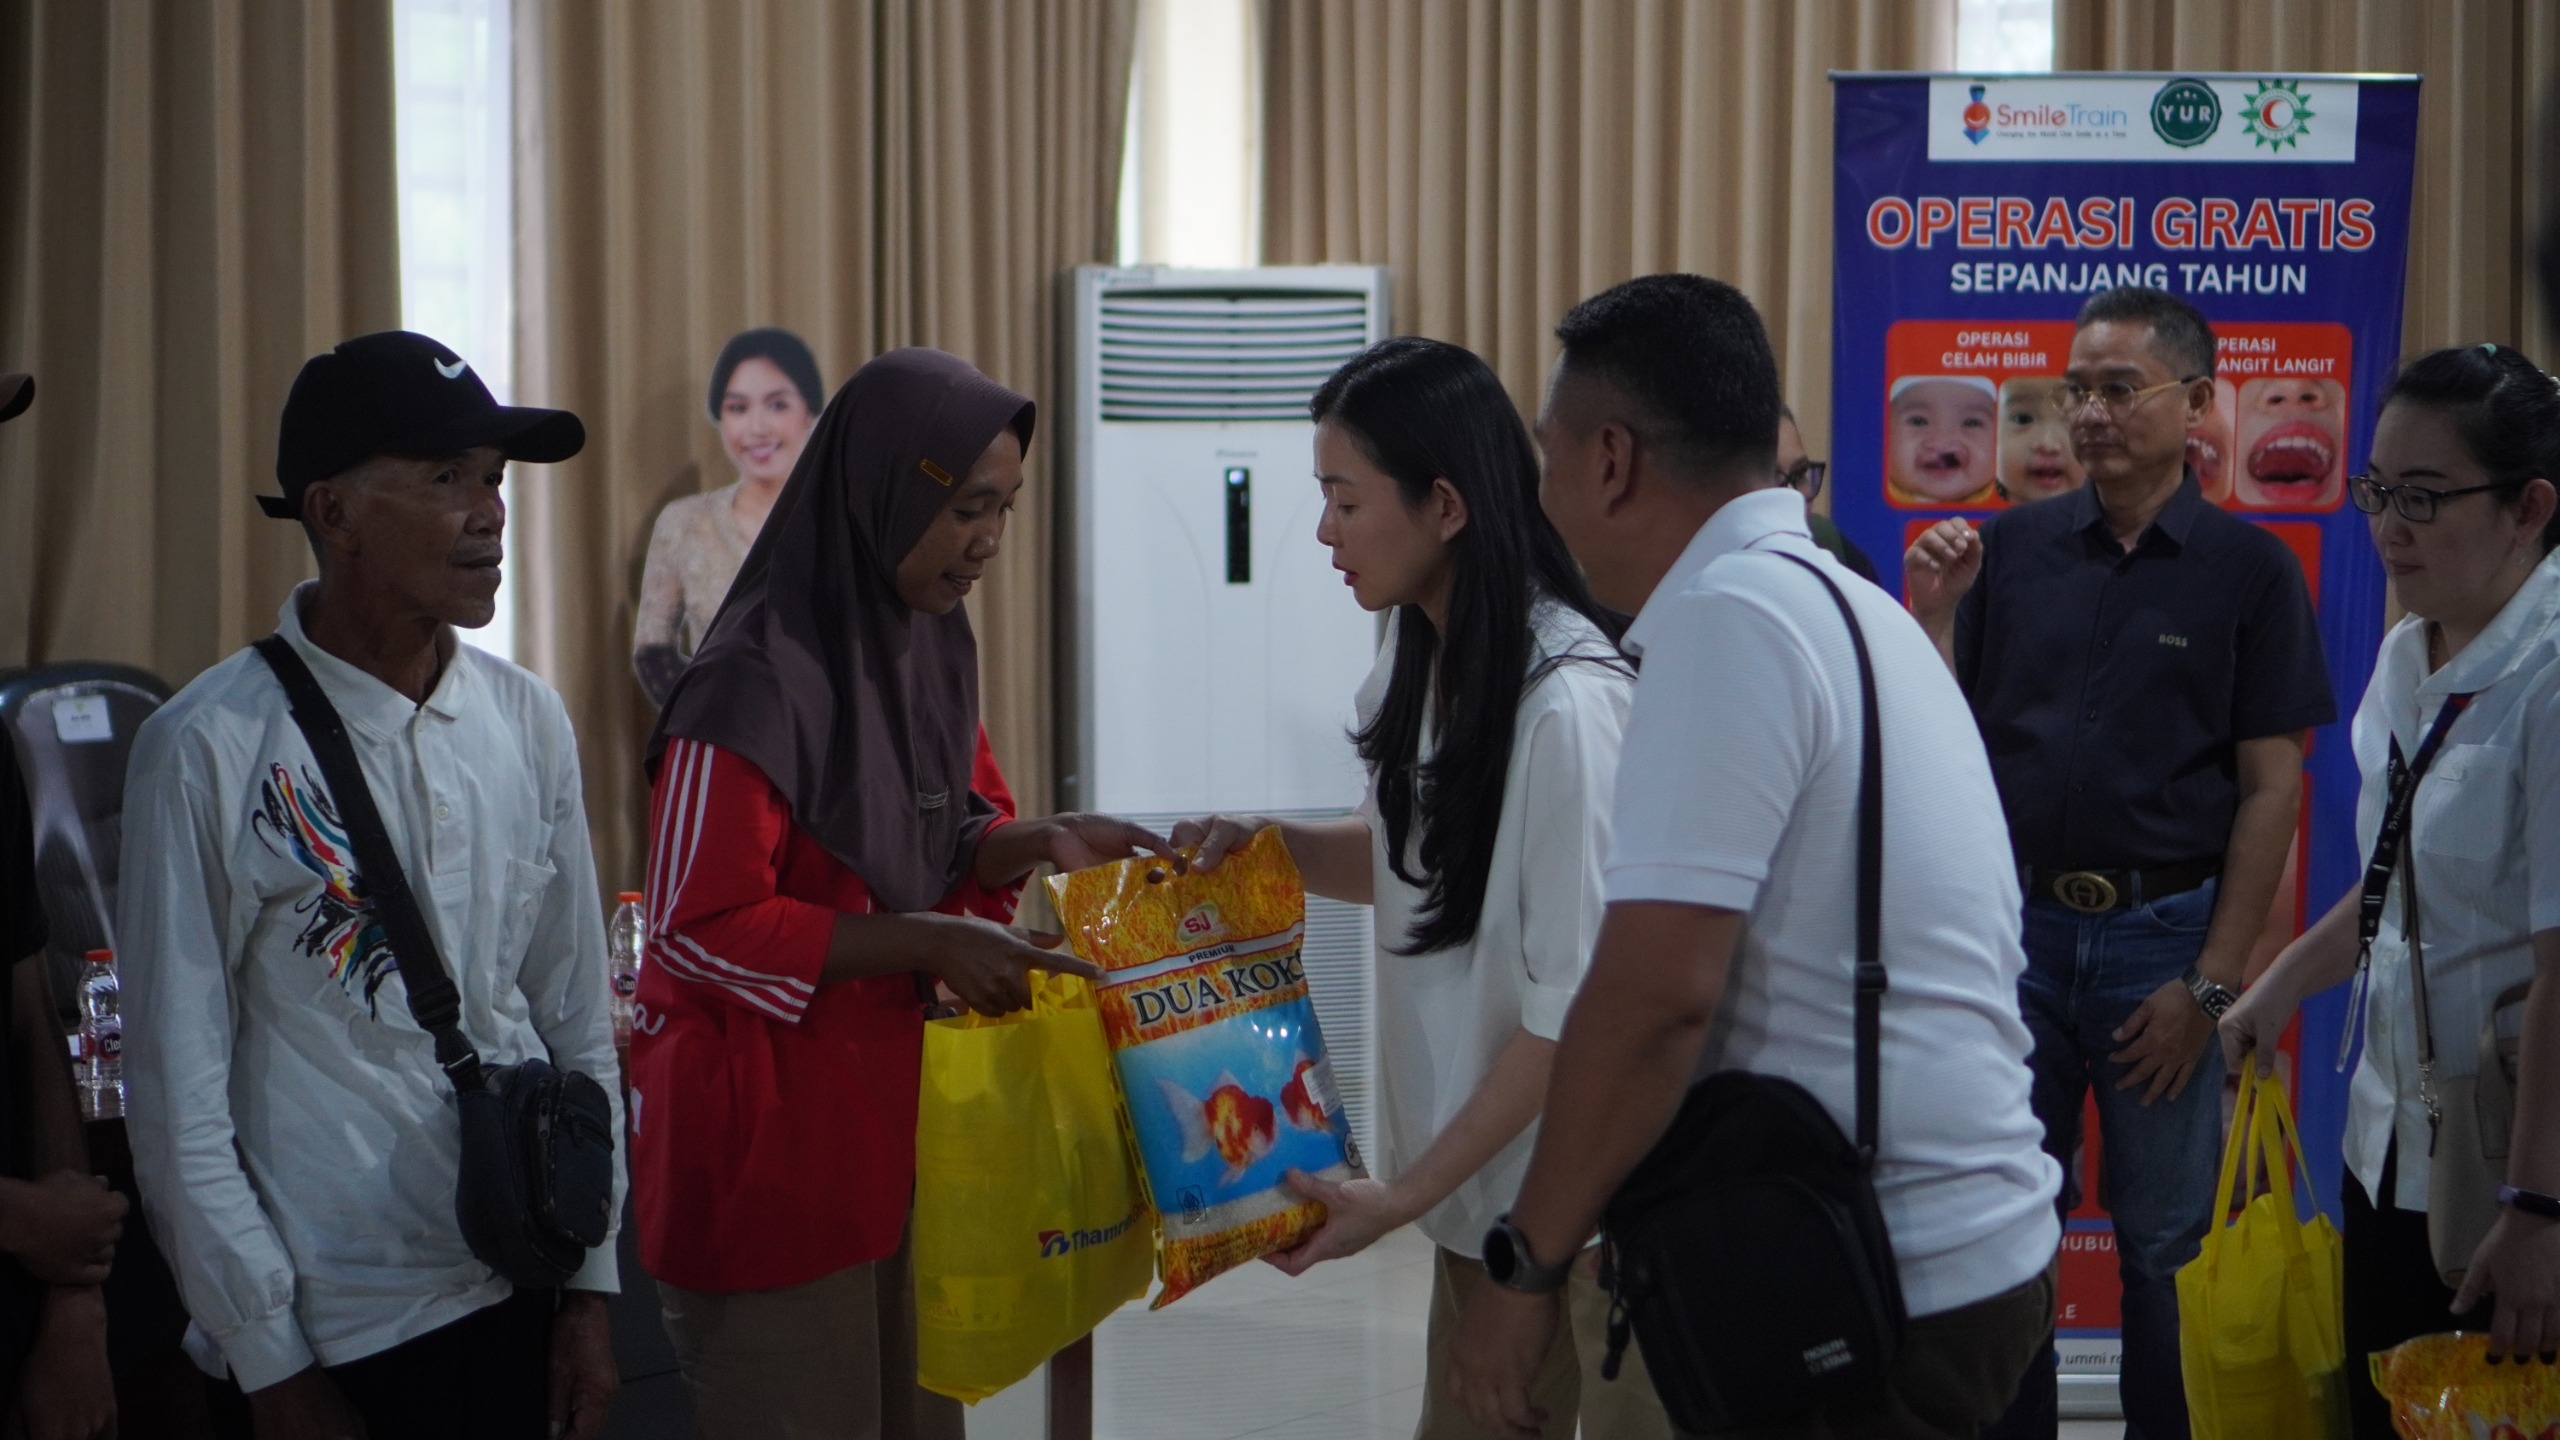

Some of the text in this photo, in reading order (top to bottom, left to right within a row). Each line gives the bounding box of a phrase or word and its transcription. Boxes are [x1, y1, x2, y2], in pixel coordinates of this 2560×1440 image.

[1997, 104, 2127, 126] SmileTrain
[2161, 105, 2211, 122] YUR
[1867, 197, 2376, 251] OPERASI GRATIS
[1950, 262, 2307, 293] SEPANJANG TAHUN
[1956, 331, 2029, 347] OPERASI
[2218, 337, 2276, 353] PERASI
[1941, 352, 2047, 367] CELAH BIBIR
[2217, 357, 2335, 373] ANGIT LANGIT
[2159, 634, 2188, 648] BOSS
[1184, 911, 1212, 934] SJ
[1131, 977, 1225, 1026] DUA
[2065, 1352, 2106, 1365] ummi
